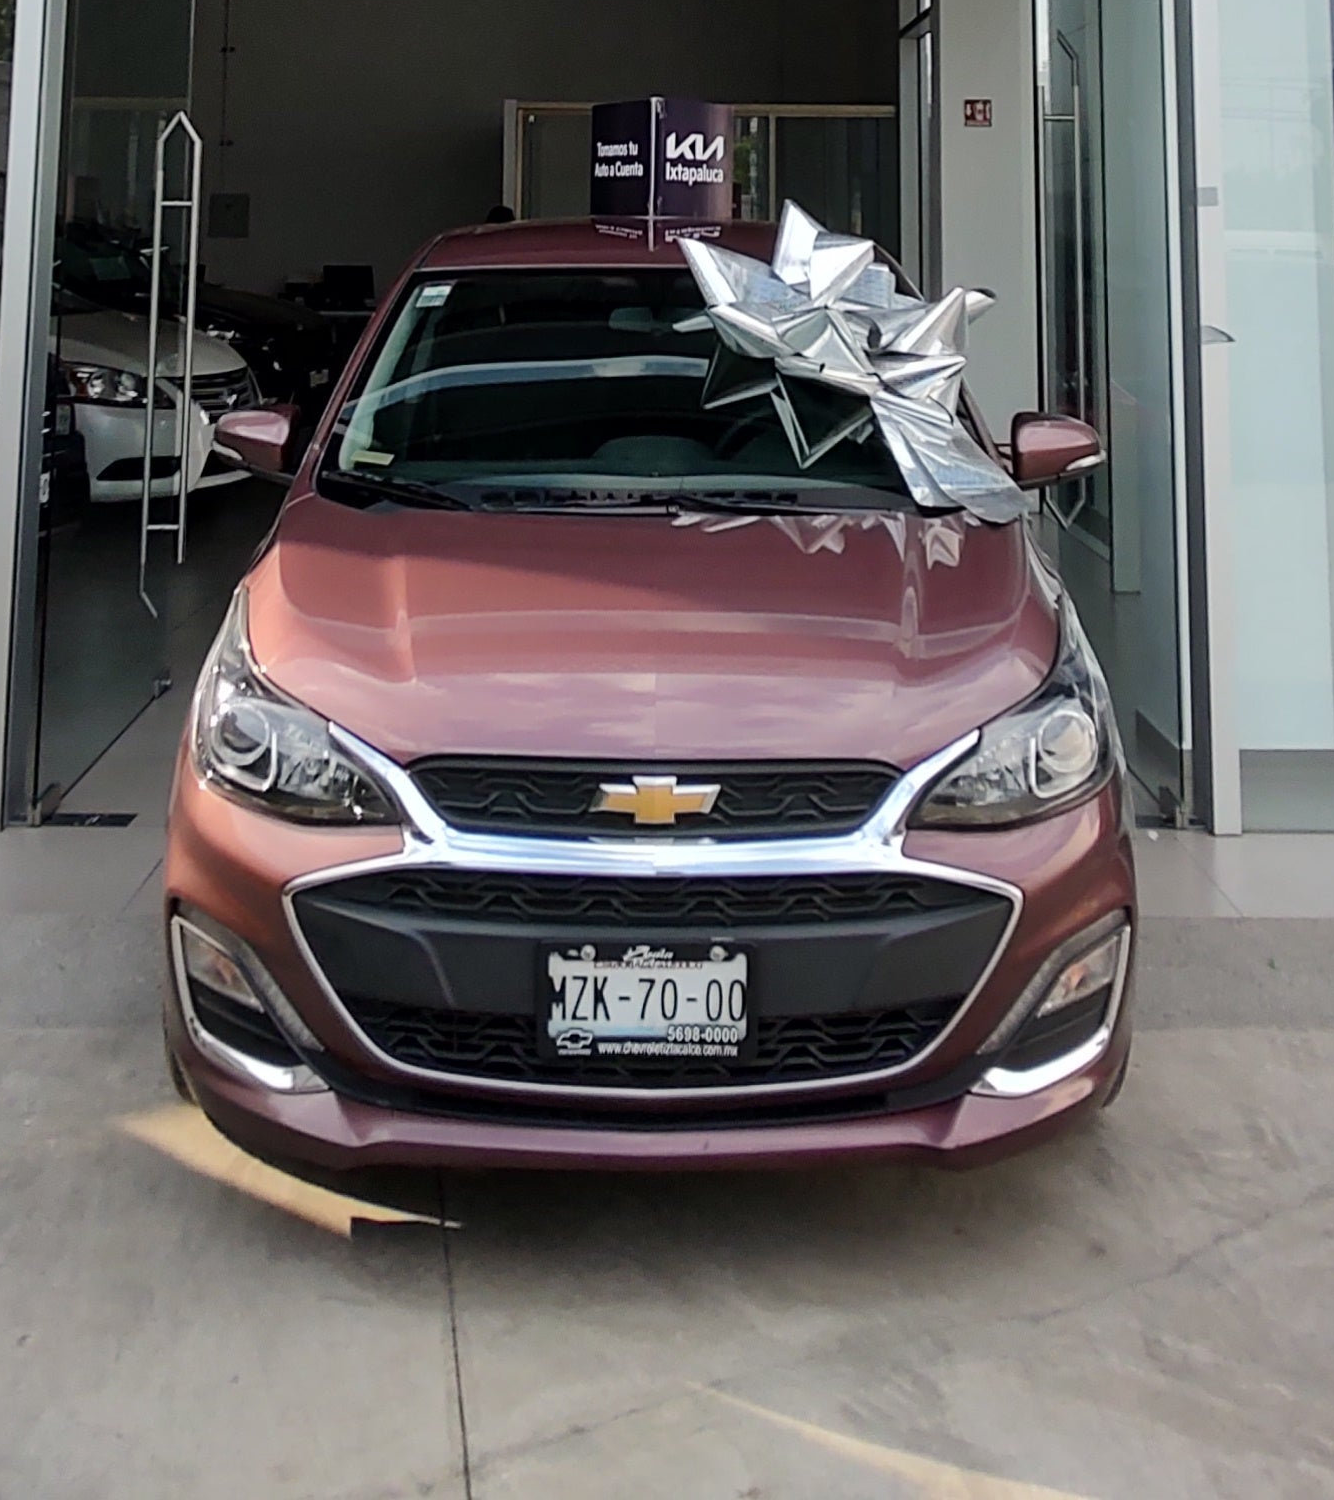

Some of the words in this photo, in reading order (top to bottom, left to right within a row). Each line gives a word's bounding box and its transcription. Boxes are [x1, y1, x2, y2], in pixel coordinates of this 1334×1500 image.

[596, 142, 628, 158] Tomamos
[629, 141, 639, 156] tu
[594, 162, 610, 177] Auto
[615, 161, 644, 177] Cuenta
[665, 162, 725, 187] Ixtapaluca
[549, 975, 747, 1022] MZK-70-00
[667, 1025, 739, 1043] 5698-0000
